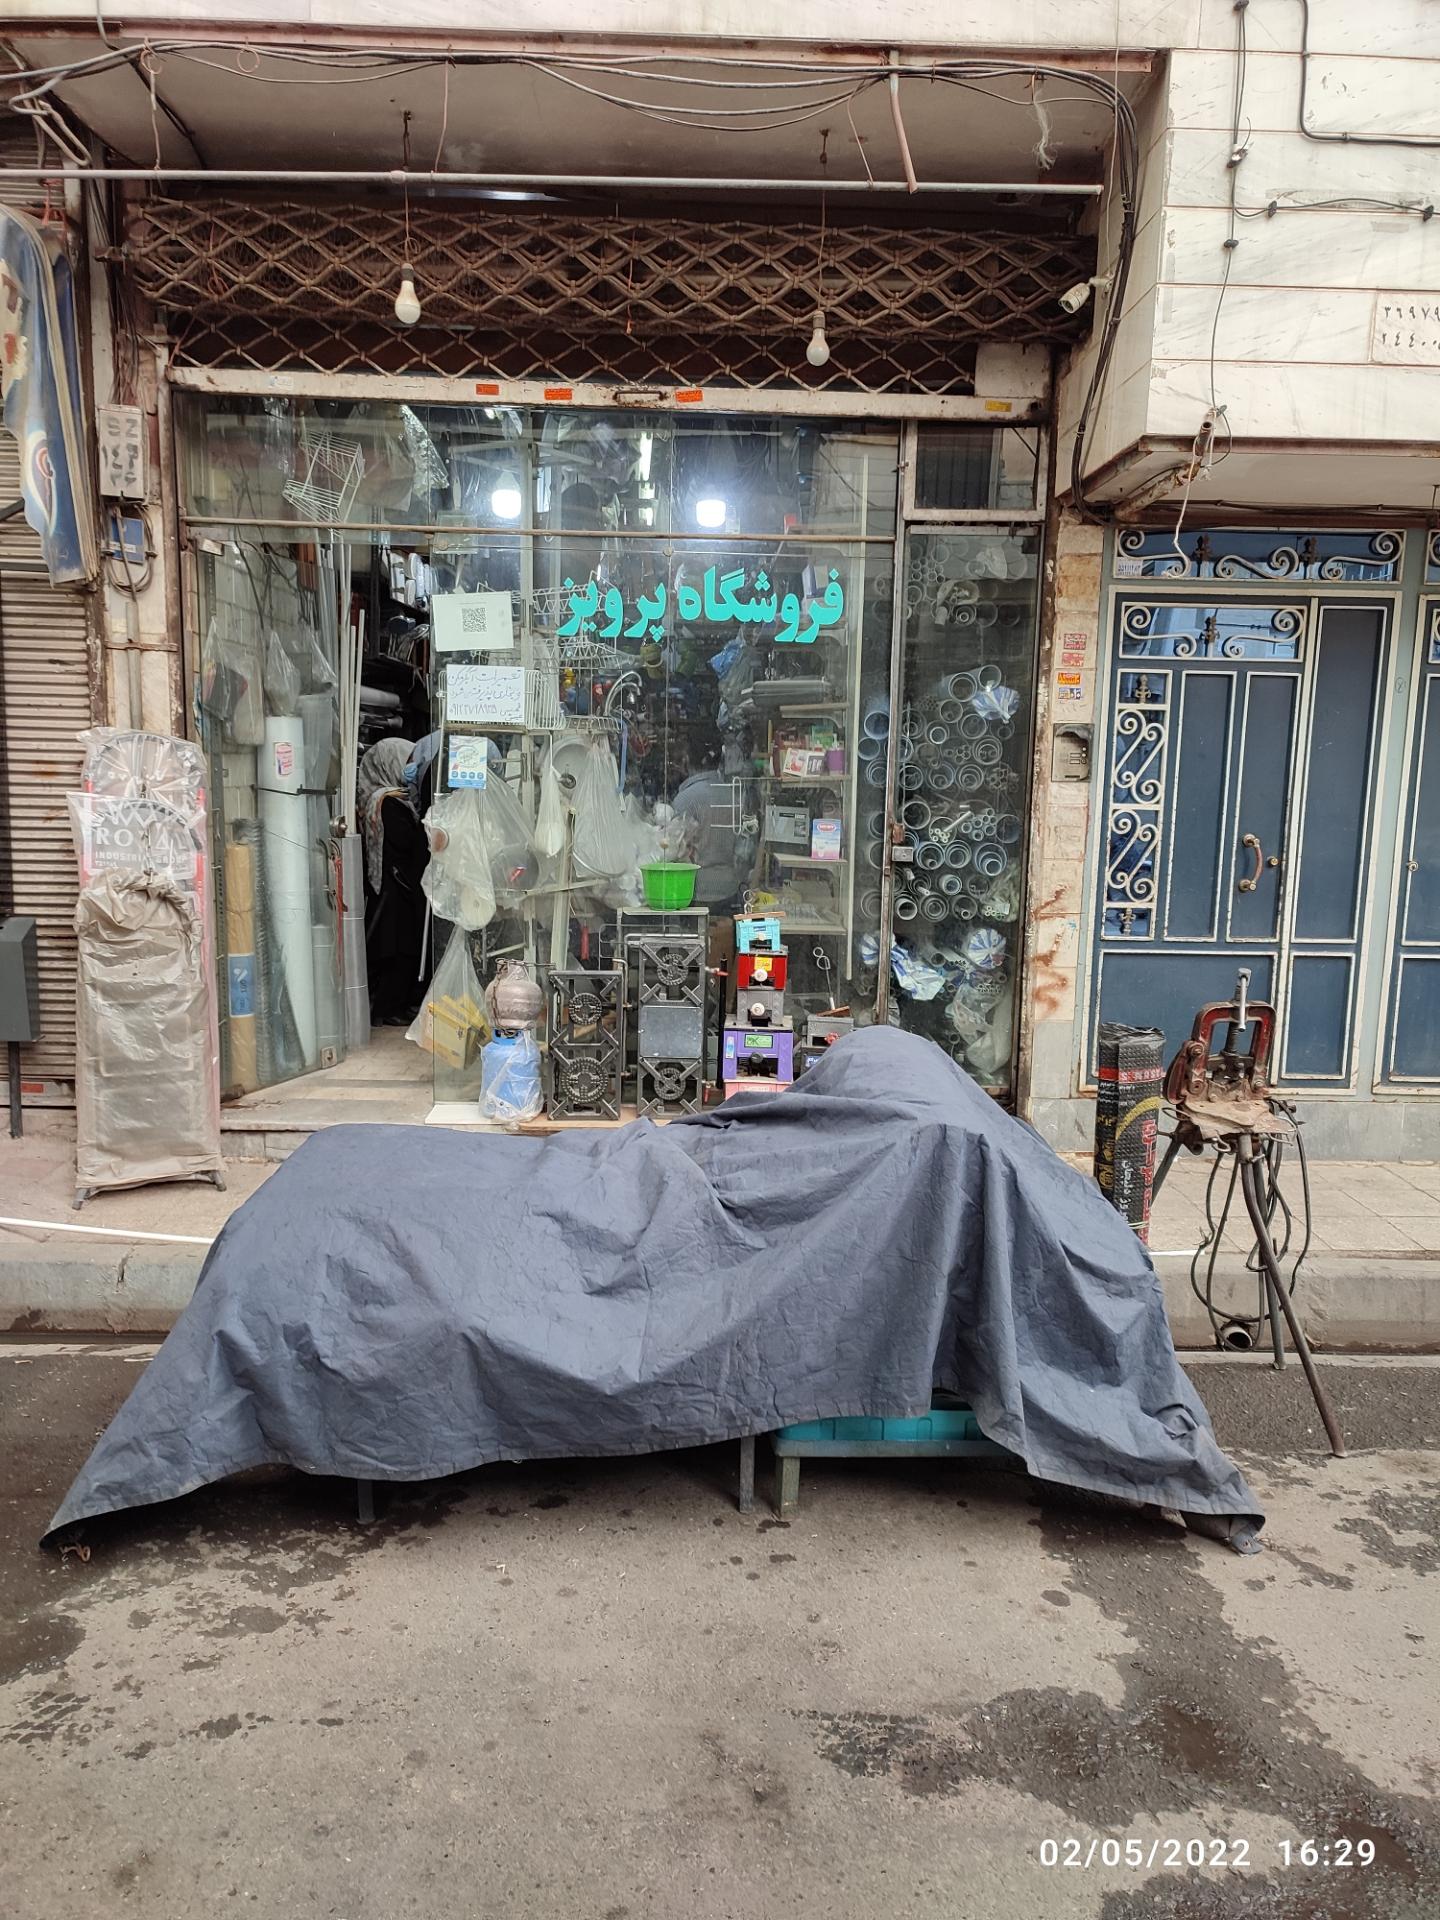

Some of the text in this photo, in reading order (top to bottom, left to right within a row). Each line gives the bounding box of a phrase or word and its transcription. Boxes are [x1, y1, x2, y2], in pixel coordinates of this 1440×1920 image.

[556, 565, 844, 643] فروشگاه پرویز
[96, 824, 188, 850] ROAL
